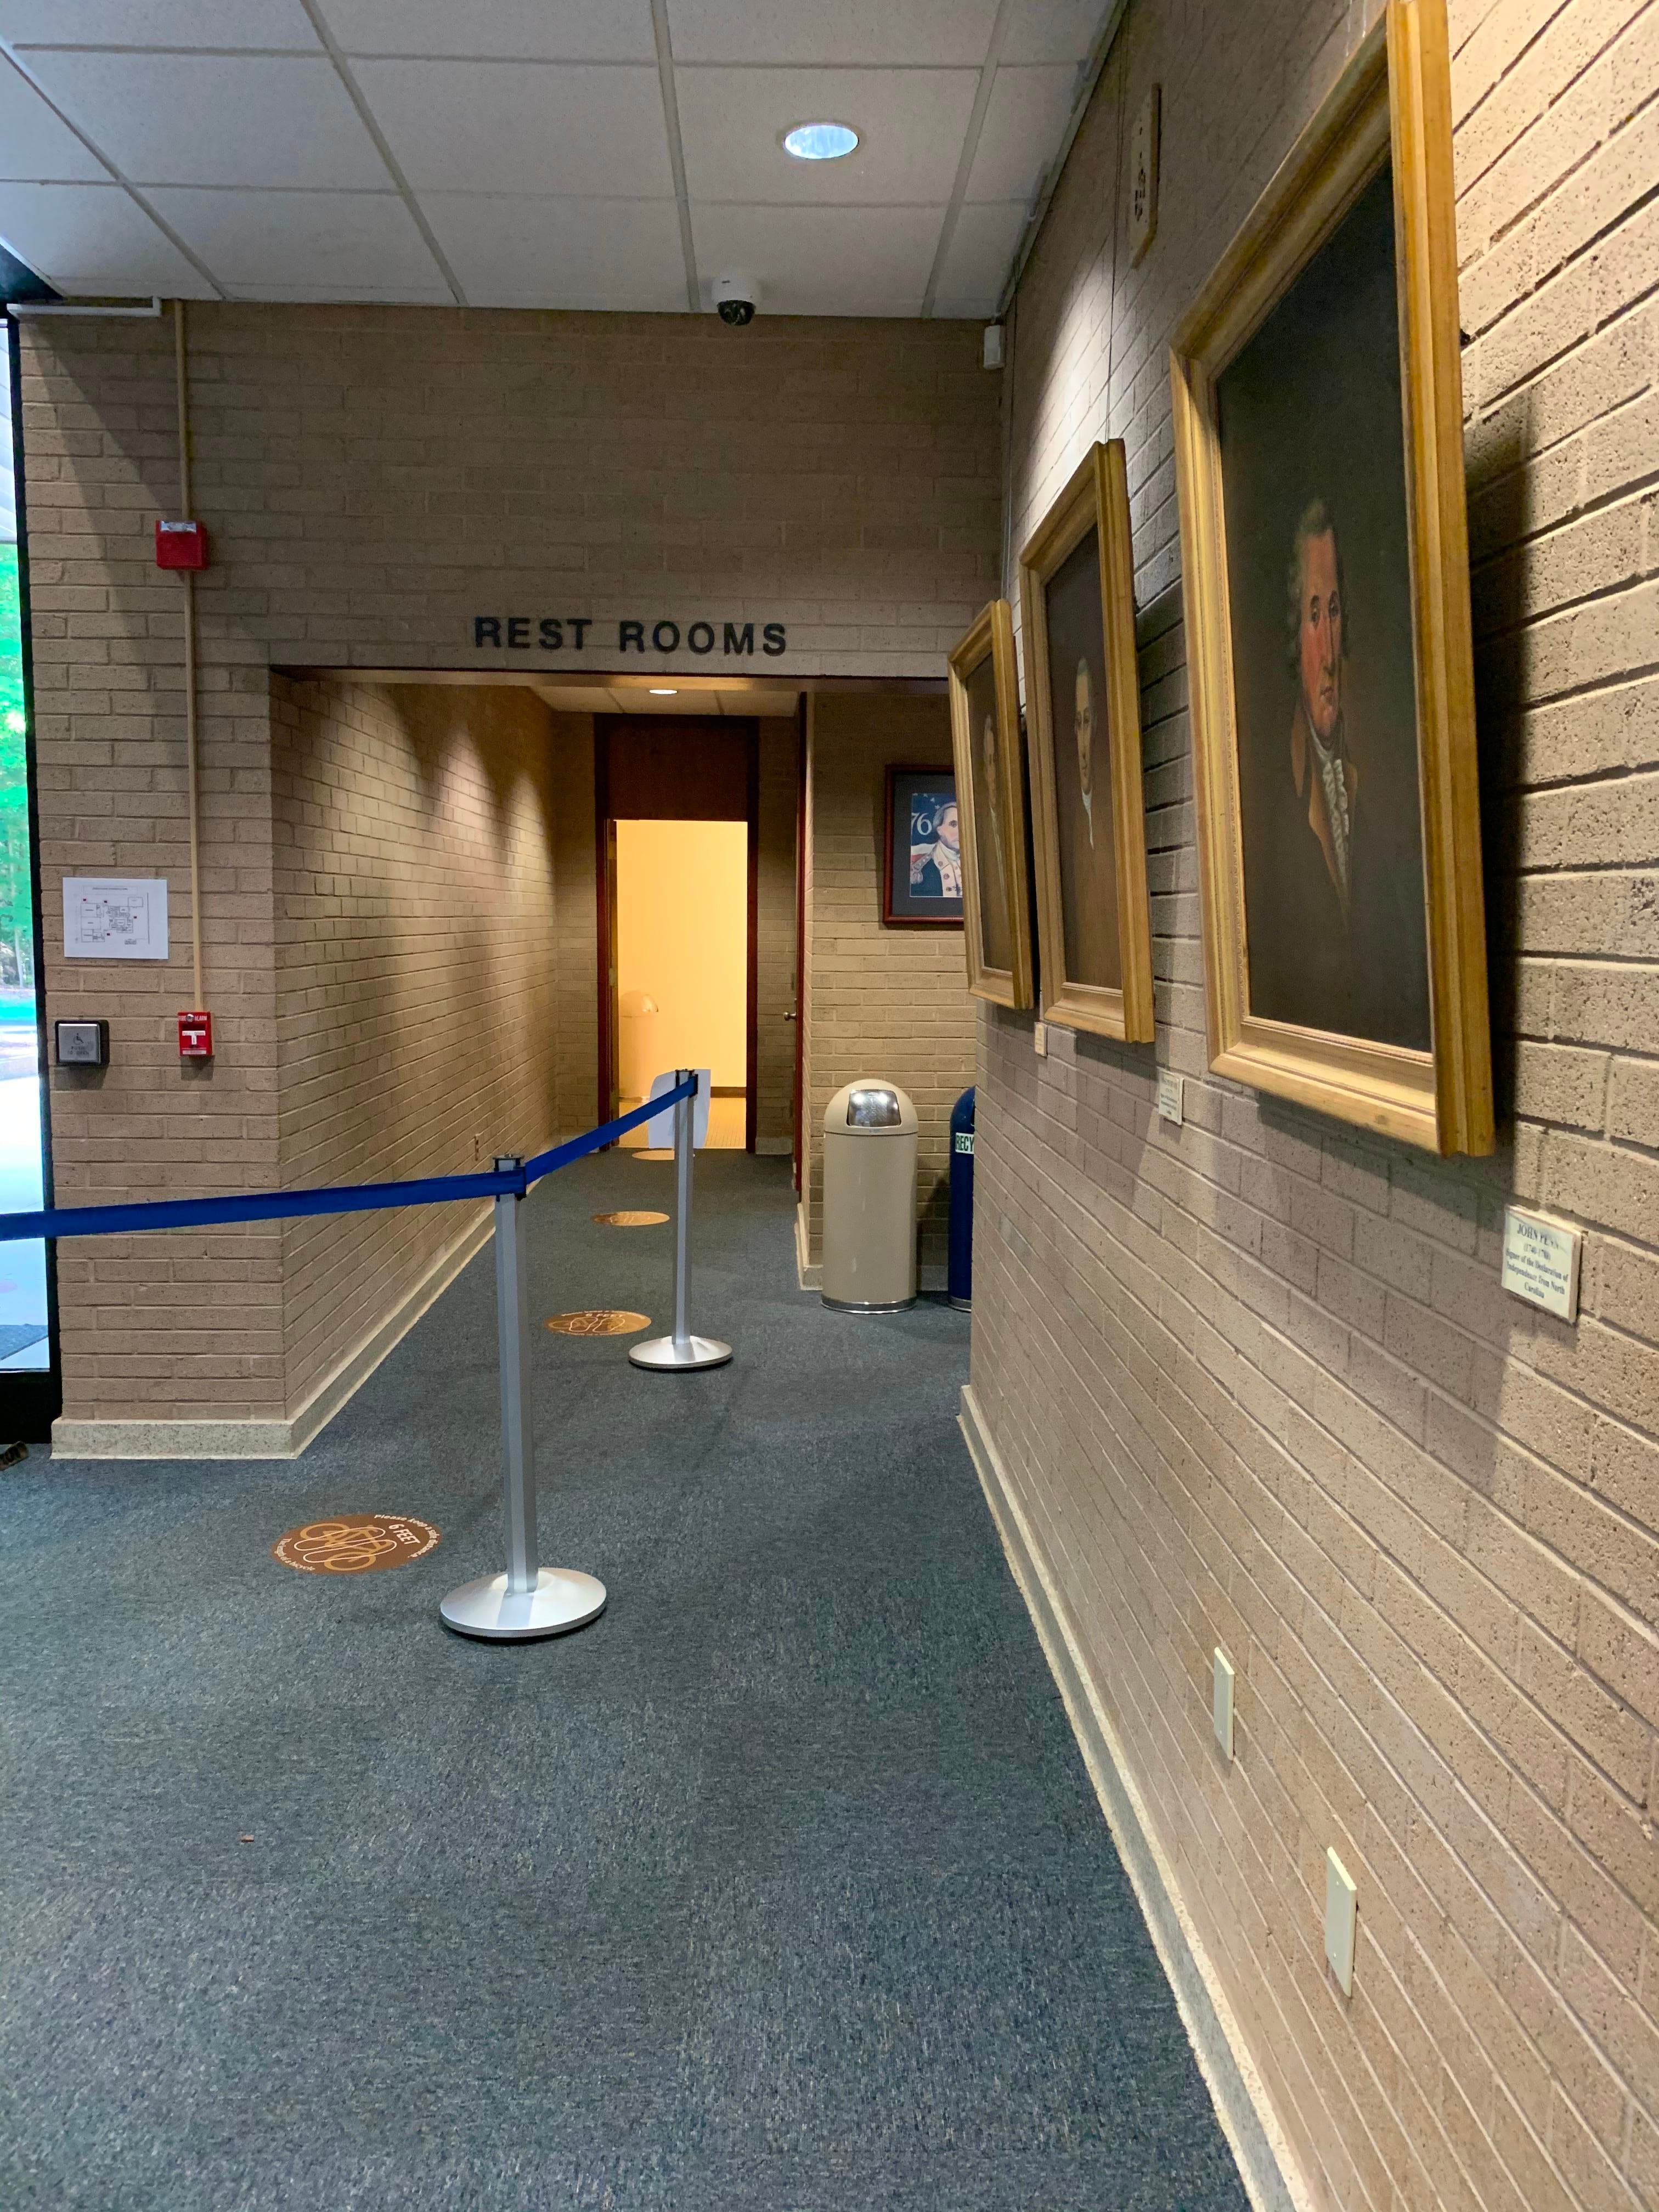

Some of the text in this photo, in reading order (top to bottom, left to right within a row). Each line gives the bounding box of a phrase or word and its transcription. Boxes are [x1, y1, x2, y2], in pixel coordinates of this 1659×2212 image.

[475, 617, 786, 656] REST ROOMS
[1517, 1223, 1537, 1241] JOHN
[393, 1528, 421, 1544] FEET
